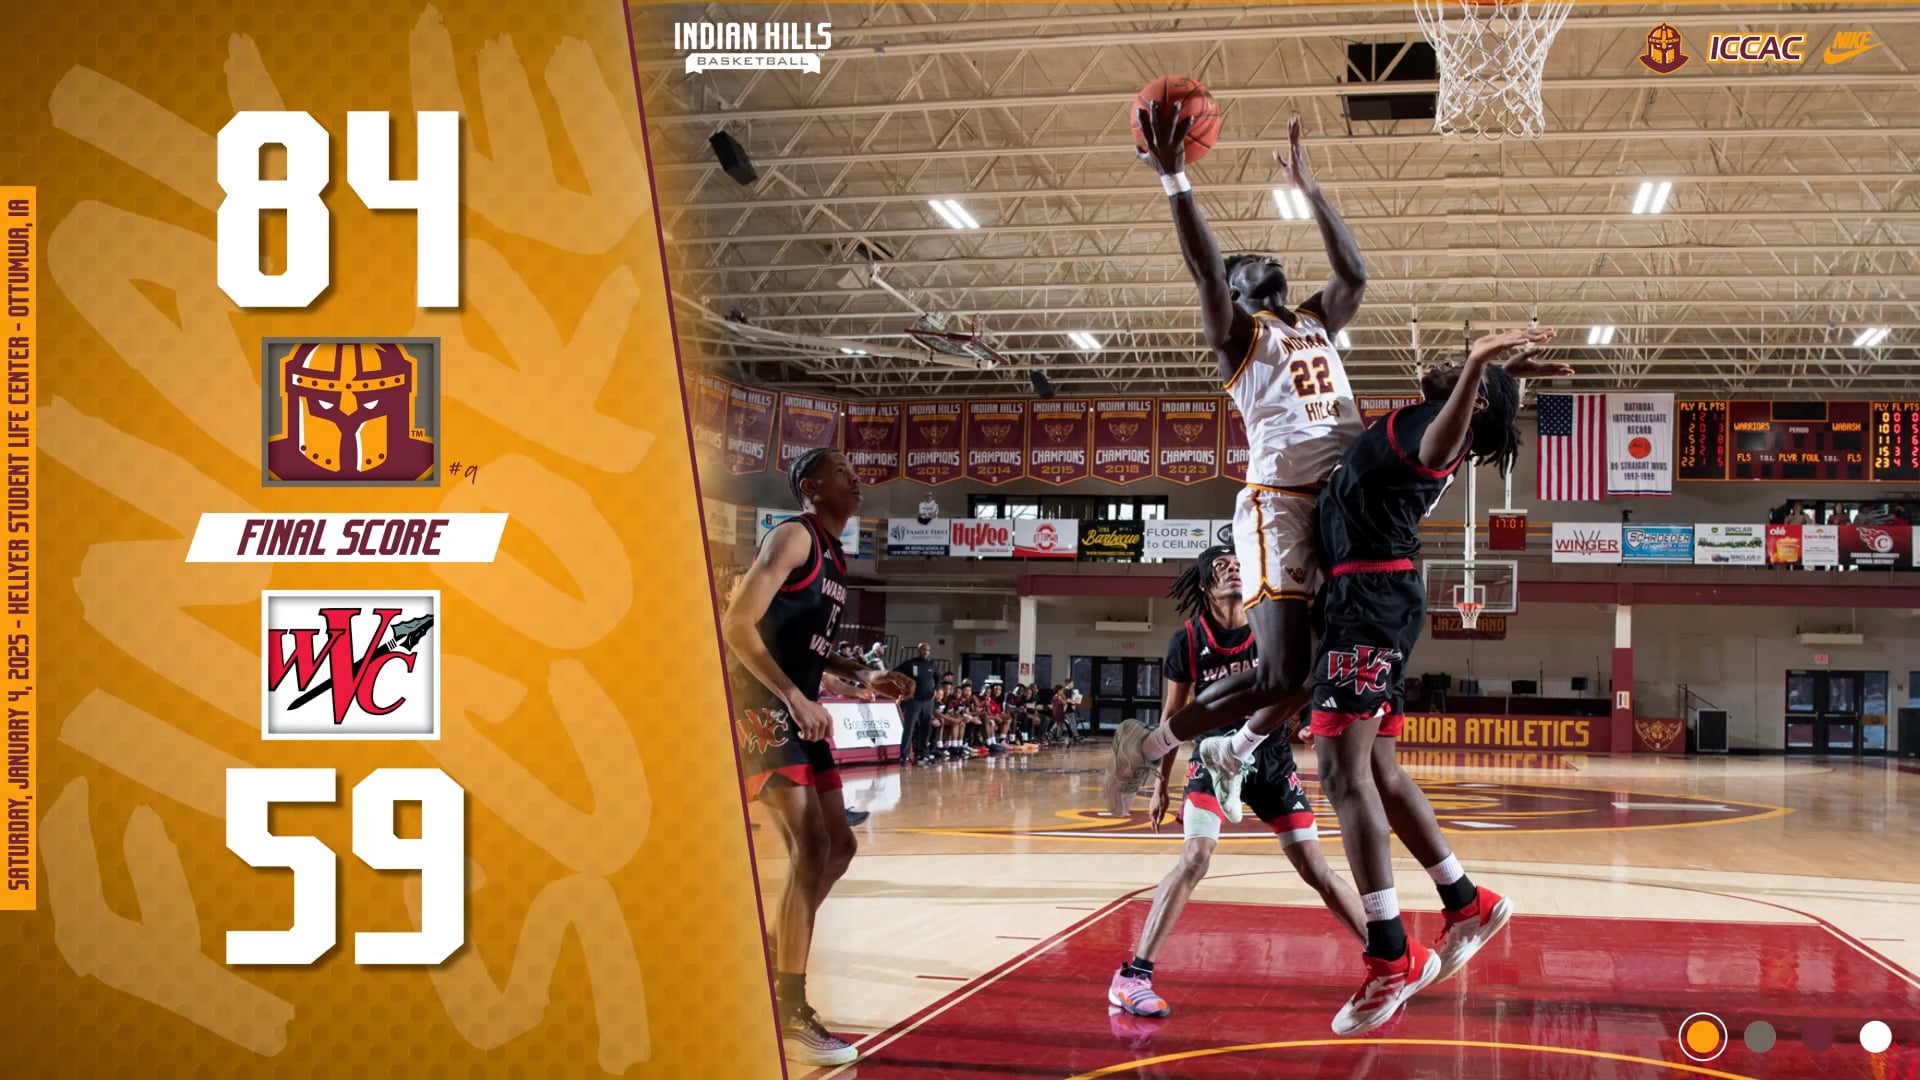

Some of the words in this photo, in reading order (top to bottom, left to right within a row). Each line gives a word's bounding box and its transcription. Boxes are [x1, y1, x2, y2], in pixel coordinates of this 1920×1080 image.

[1280, 333, 1328, 354] INDIAN
[1290, 356, 1334, 398] 22
[1624, 402, 1654, 411] NATIONAL
[1681, 402, 1695, 411] PLY
[1698, 402, 1708, 411] FL
[1710, 402, 1725, 411] PTS
[1875, 403, 1888, 411] PLY
[1892, 403, 1902, 411] FL
[1904, 403, 1920, 411] PTS
[1613, 414, 1667, 423] INTERCOLLEGIATE
[1699, 412, 1706, 421] 2
[1882, 412, 1889, 422] 0
[1893, 412, 1900, 422] 0
[1912, 412, 1918, 422] 0
[1627, 425, 1652, 434] RECORD
[1688, 423, 1695, 433] 2
[1699, 423, 1706, 432] 0
[1734, 422, 1770, 431] WARRIORS
[1832, 423, 1861, 431] WABASH
[1879, 424, 1889, 434] 10
[1893, 424, 1900, 433] 0
[1912, 424, 1918, 433] 5
[1688, 434, 1695, 444] 5
[1699, 434, 1706, 443] 2
[1879, 435, 1889, 444] 11
[1912, 435, 1918, 445] 6
[1685, 445, 1695, 455] 13
[1699, 445, 1706, 455] 2
[1879, 446, 1889, 456] 15
[1894, 446, 1900, 456] 3
[1912, 446, 1918, 456] 2
[847, 452, 898, 466] CHAMPIONS
[908, 451, 960, 466] CHAMPIONS
[969, 451, 1021, 466] CHAMPIONS
[1032, 450, 1085, 465] CHAMPIONS
[1096, 449, 1150, 465] CHAMPIONS
[1161, 449, 1215, 465] CHAMPIONS
[1681, 457, 1695, 467] 22
[1717, 457, 1724, 467] 5
[1737, 453, 1752, 461] FLS
[1779, 453, 1797, 462] PLYR
[1802, 453, 1820, 462] FOUL
[1847, 453, 1862, 462] FLS
[1621, 461, 1649, 470] STRAIGHT
[1875, 457, 1889, 468] 23
[1893, 458, 1900, 466] 4
[1912, 457, 1918, 468] 5
[859, 468, 887, 476] 2011
[917, 466, 950, 475] 2012
[977, 466, 1011, 474] 2014
[1041, 466, 1074, 474] 2015
[1168, 465, 1207, 474] 2023
[1146, 528, 1188, 537] FLOOR
[1630, 532, 1690, 543] SCHROEDER
[1082, 529, 1140, 549] Barbecue
[1147, 541, 1158, 549] to
[1162, 540, 1208, 549] CEILING
[1555, 539, 1618, 551] WINGER
[1434, 617, 1463, 631] JAZZ
[1328, 645, 1394, 695] WVC
[1397, 717, 1456, 743] RIOR
[1465, 718, 1590, 747] ATHLETICS
